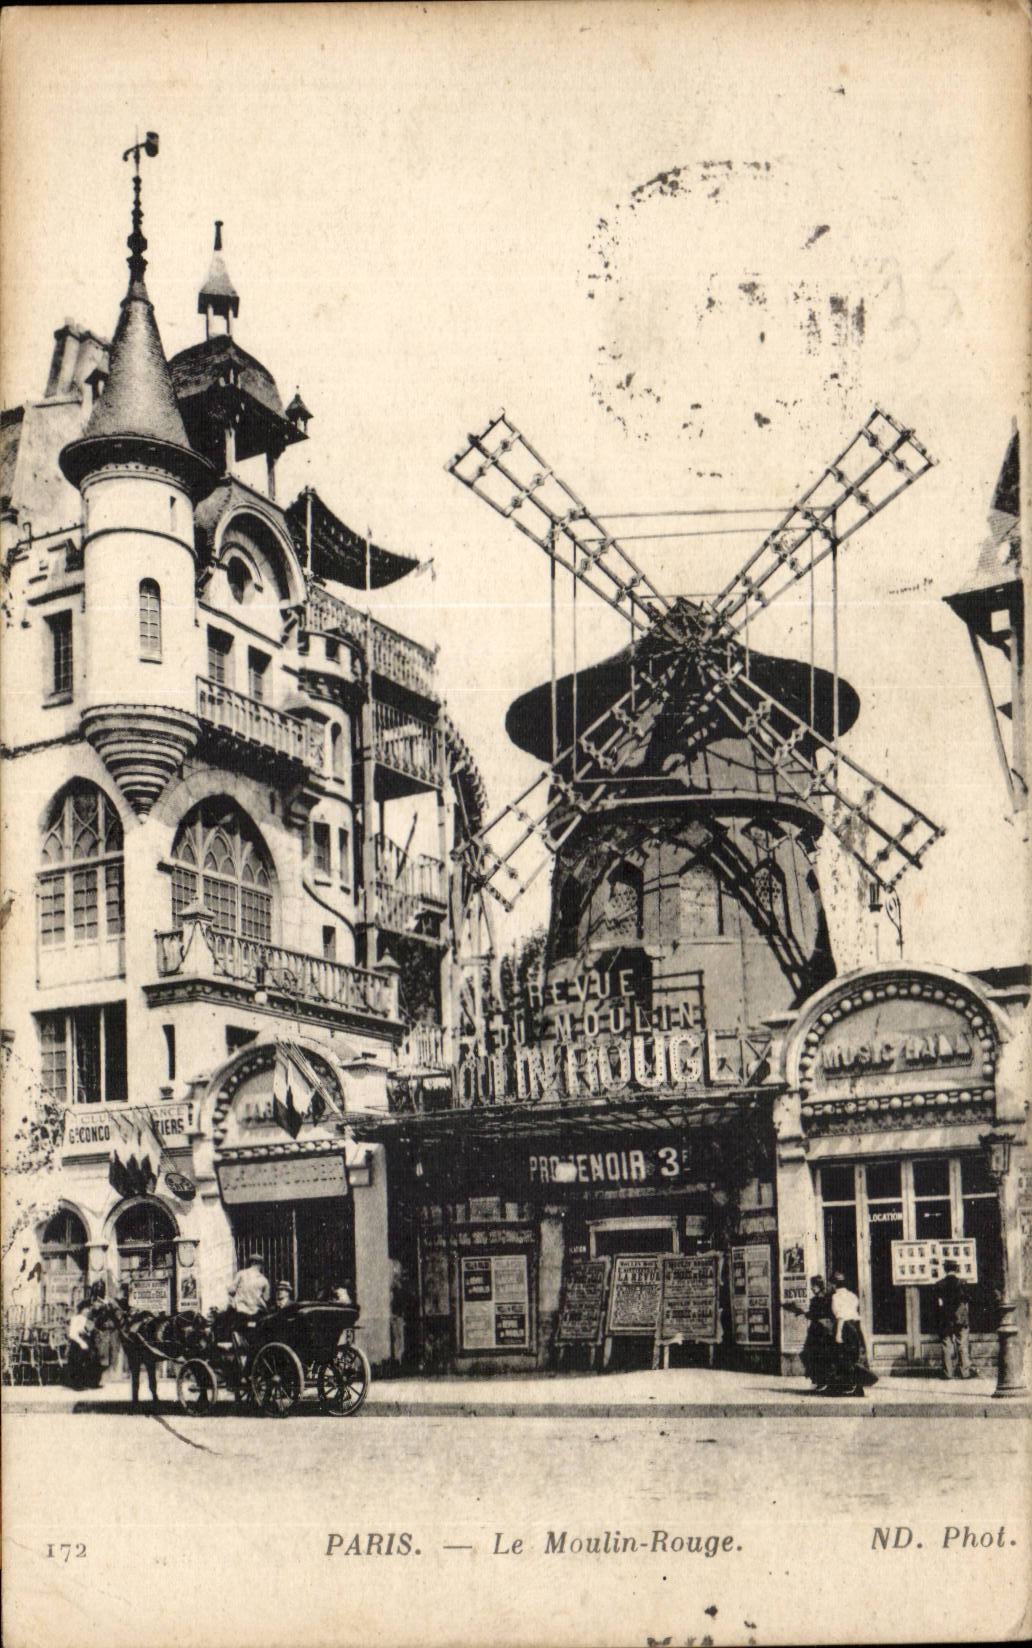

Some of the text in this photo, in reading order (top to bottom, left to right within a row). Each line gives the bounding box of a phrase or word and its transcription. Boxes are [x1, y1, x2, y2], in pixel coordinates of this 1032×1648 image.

[528, 968, 636, 1007] REVUE
[554, 1001, 697, 1041] MOULIN
[452, 1029, 741, 1107] OULIN ROUGE
[79, 1125, 111, 1144] CONCO
[153, 1118, 185, 1136] TIERS
[529, 1149, 647, 1183] PROENOIR
[869, 1211, 903, 1223] LOCATION
